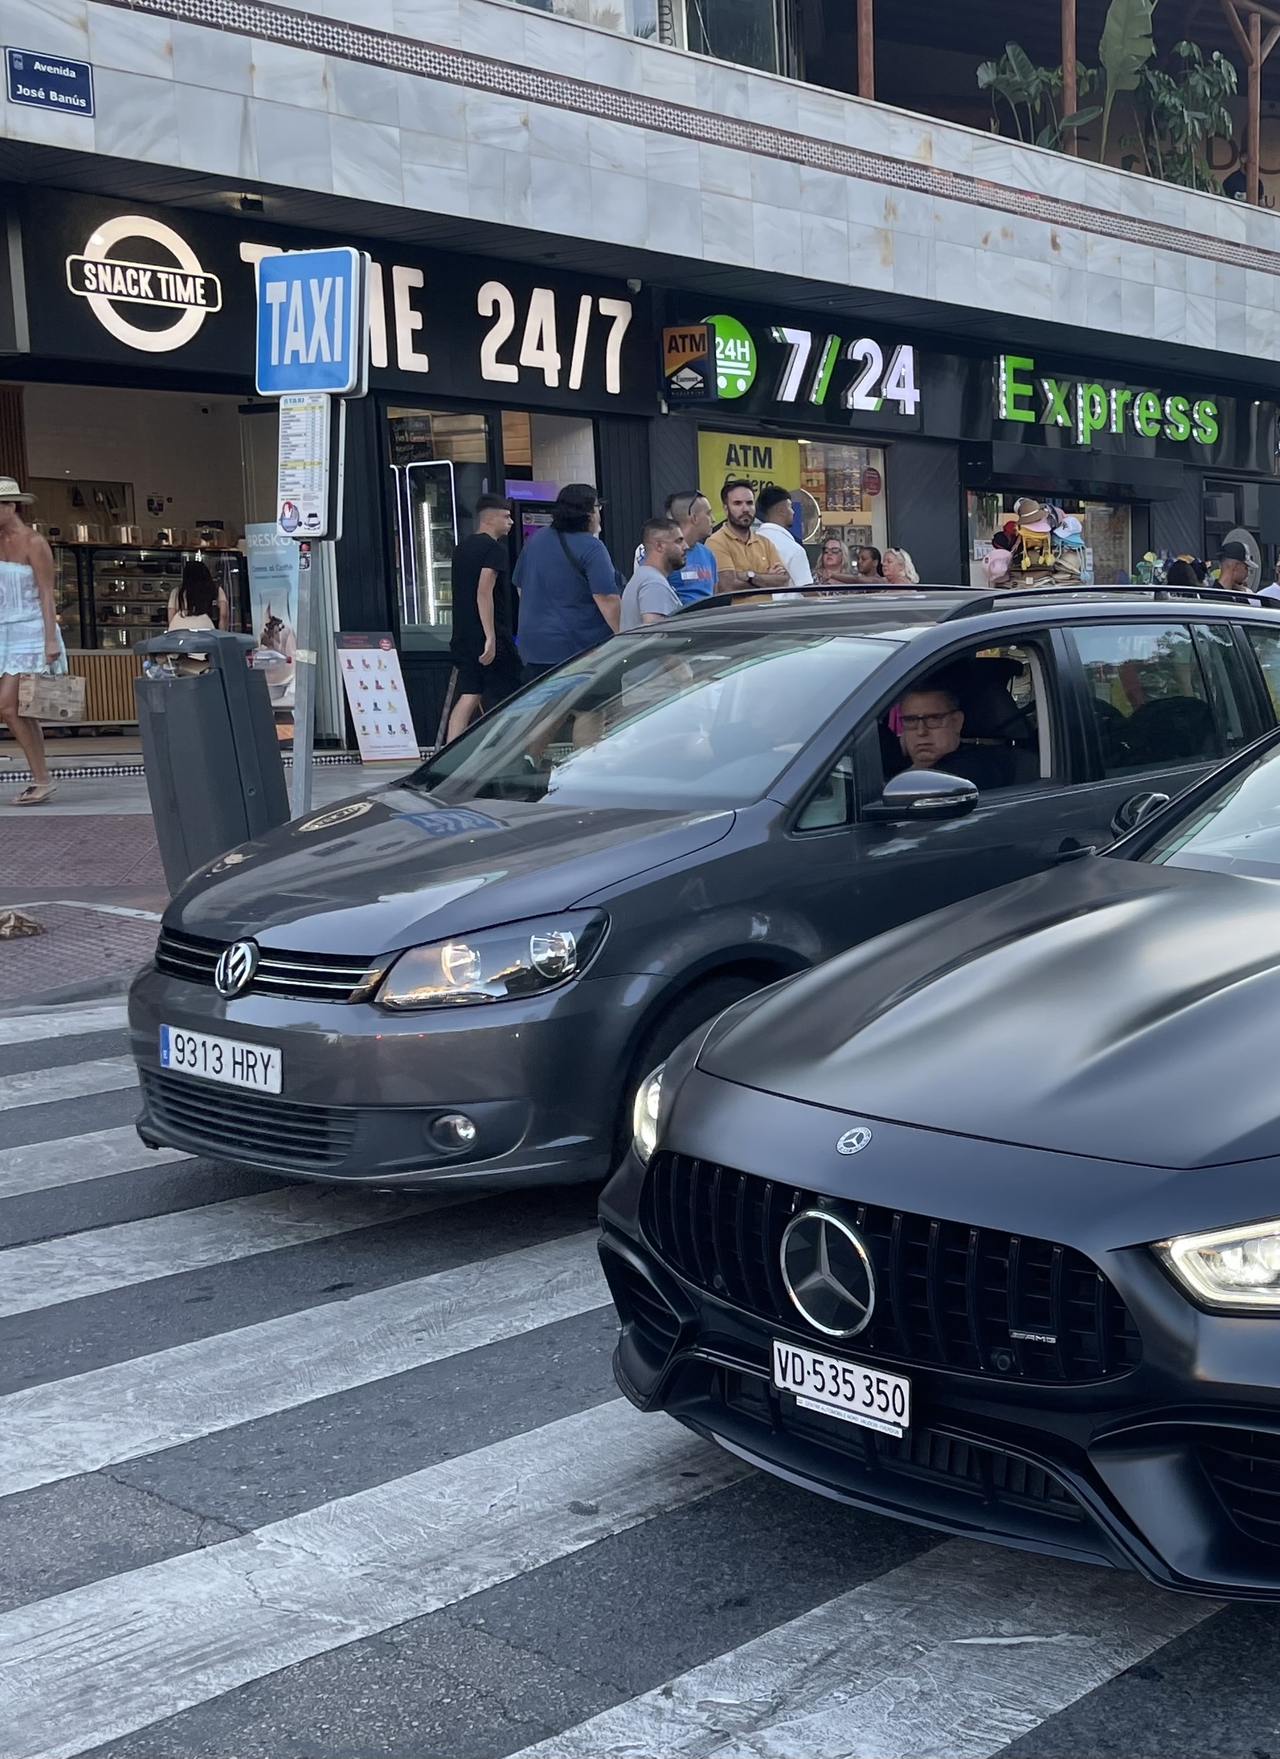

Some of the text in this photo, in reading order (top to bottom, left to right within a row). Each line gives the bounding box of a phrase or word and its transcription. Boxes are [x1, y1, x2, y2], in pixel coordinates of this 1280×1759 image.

[33, 61, 77, 78] Avenida
[16, 84, 87, 107] José Banús
[83, 263, 207, 305] SNACK TIME
[265, 276, 344, 366] TAXI
[477, 280, 633, 394] 24/7
[667, 333, 706, 354] ATM
[715, 336, 750, 362] 24H
[770, 326, 921, 415] 7/24
[999, 354, 1219, 445] Express
[725, 443, 773, 470] ATM
[174, 1033, 272, 1085] 9313 HRY
[1024, 1333, 1057, 1344] AMG
